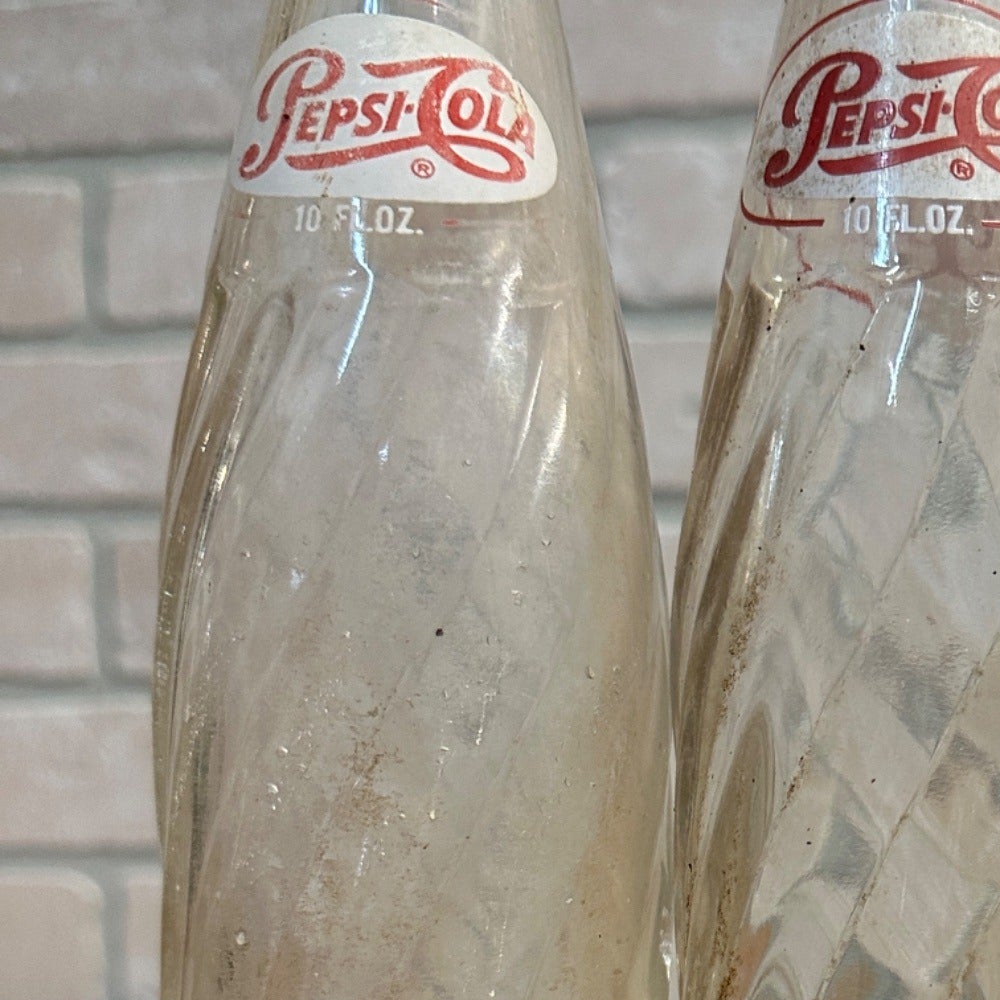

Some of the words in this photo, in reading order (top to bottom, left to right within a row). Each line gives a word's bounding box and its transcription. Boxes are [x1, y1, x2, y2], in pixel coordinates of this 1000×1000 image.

[239, 48, 536, 182] PEPSI-COLA
[295, 205, 322, 232] 10
[842, 204, 871, 235] 10
